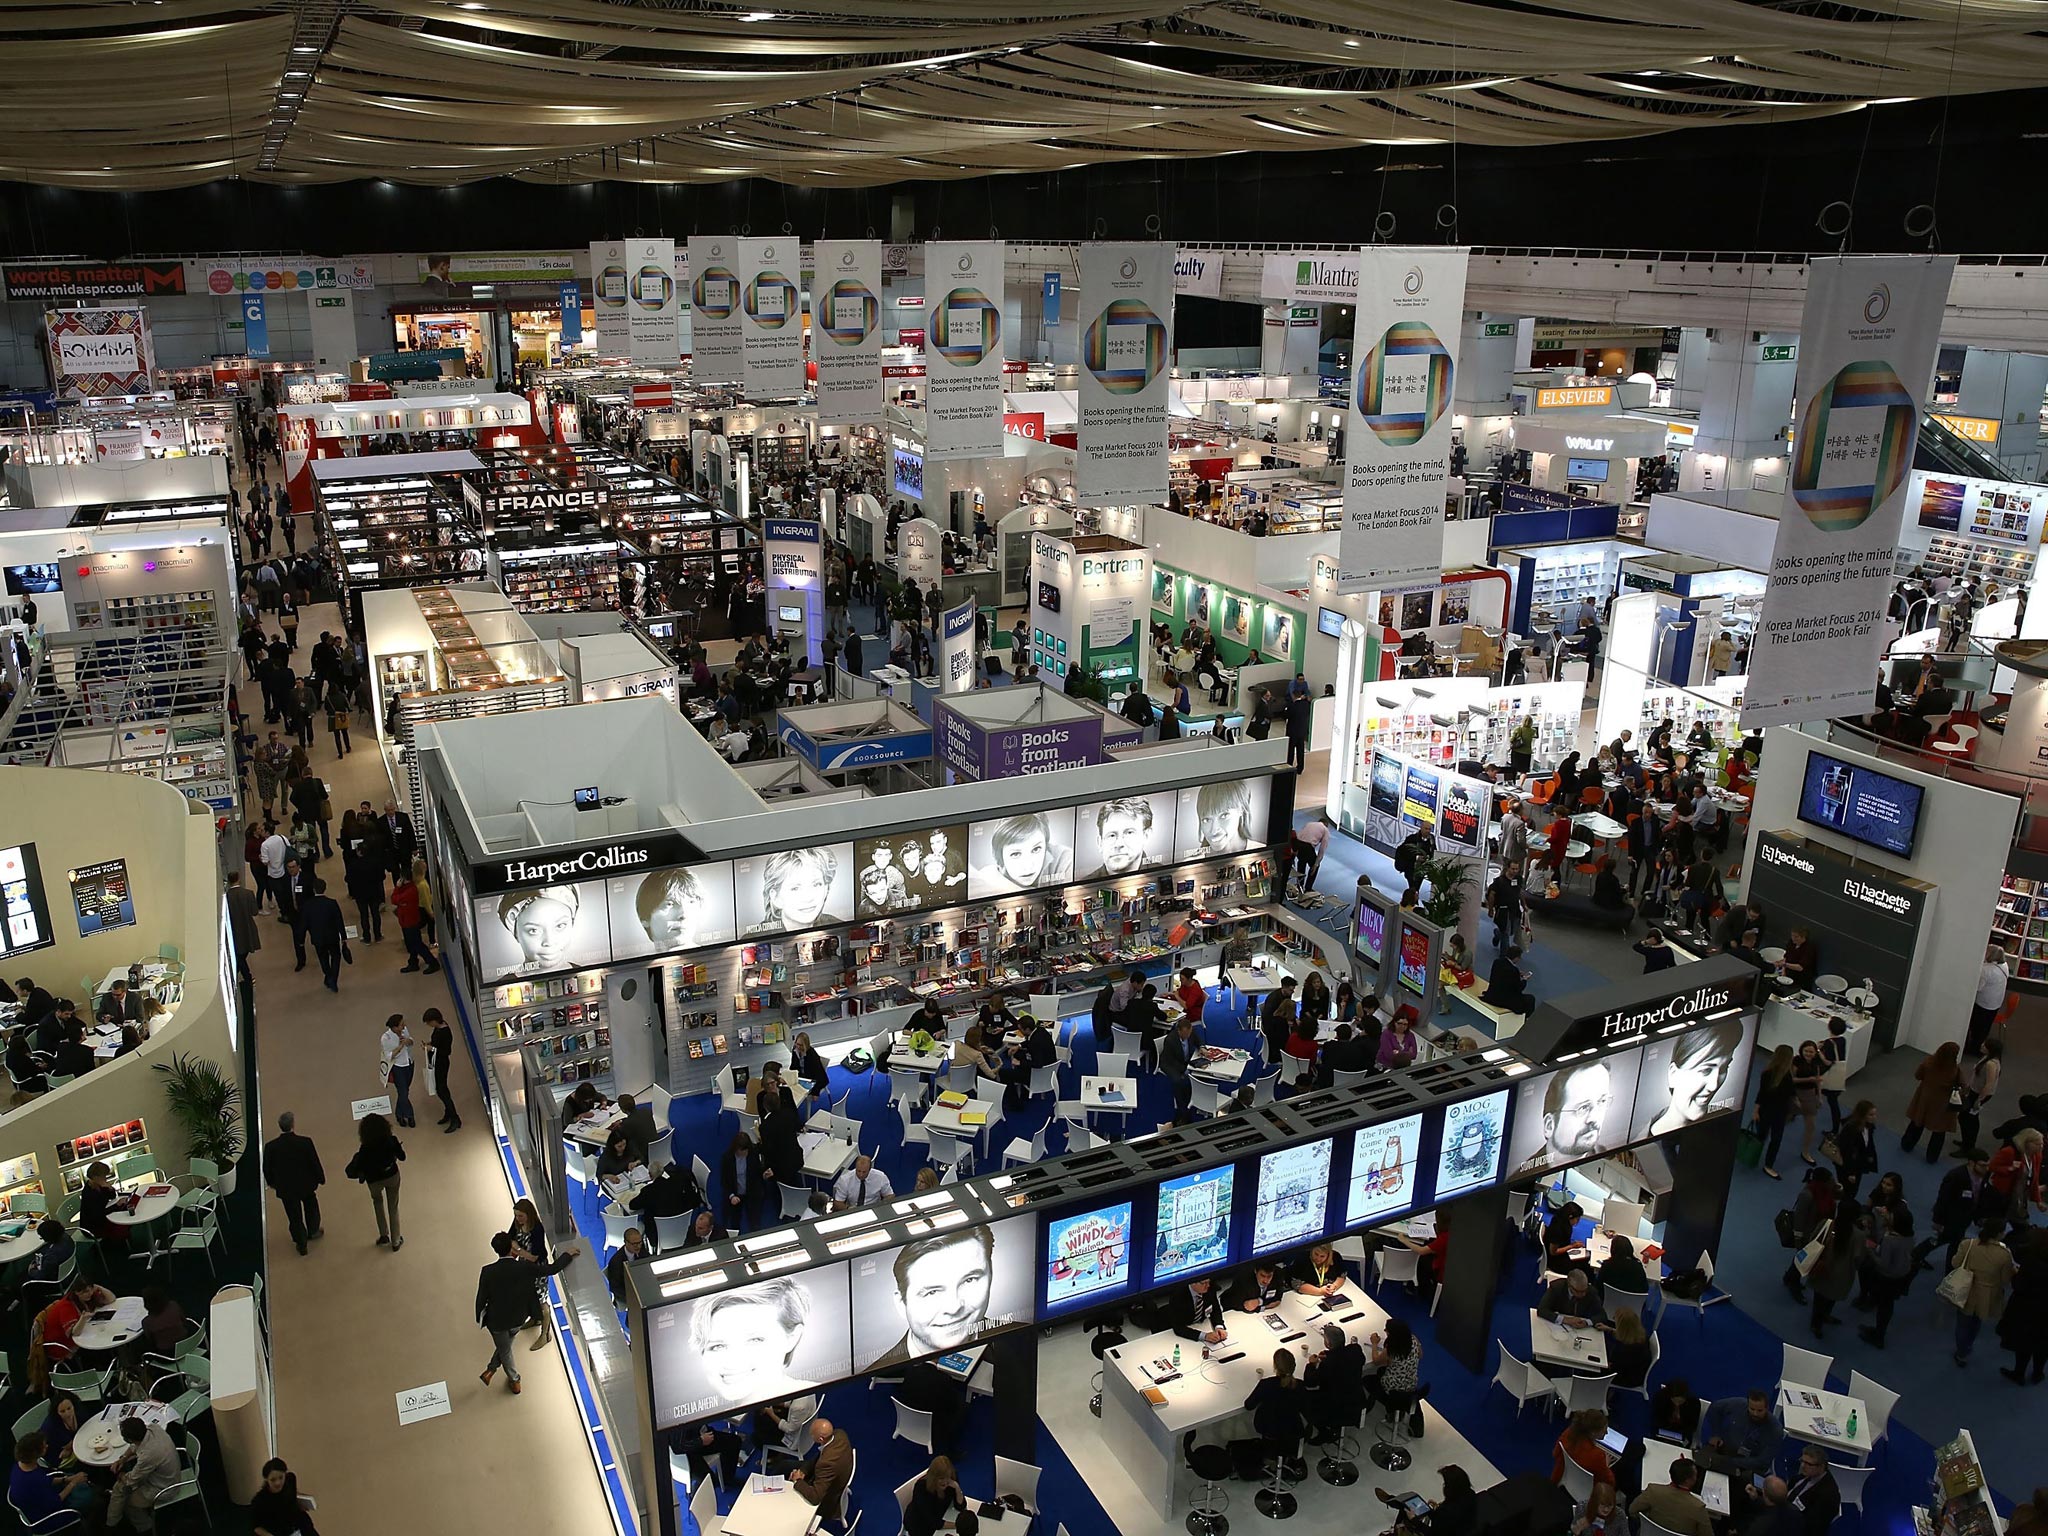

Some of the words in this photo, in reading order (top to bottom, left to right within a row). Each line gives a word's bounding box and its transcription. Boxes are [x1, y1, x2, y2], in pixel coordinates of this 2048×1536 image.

[8, 268, 72, 284] words
[76, 267, 142, 281] matter
[337, 273, 373, 288] Qbend
[10, 283, 144, 298] www.midaspr.co.uk
[1049, 284, 1055, 296] J
[565, 296, 576, 308] H
[247, 306, 262, 321] G
[1541, 328, 1565, 338] seating
[1568, 327, 1581, 336] fine
[1581, 327, 1597, 336] food
[411, 381, 438, 391] FABER
[440, 381, 448, 390] &
[450, 379, 476, 389] FABER
[1542, 390, 1606, 407] ELSEVIER
[1083, 407, 1105, 418] Books
[1106, 406, 1133, 418] opening
[1134, 405, 1146, 415] the
[1146, 404, 1166, 415] mind,
[1083, 417, 1104, 427] Doors
[1104, 416, 1132, 428] opening
[1133, 415, 1144, 425] the
[1145, 415, 1166, 425] future
[1085, 444, 1104, 453] Korea
[1105, 443, 1127, 452] Market
[1127, 442, 1146, 451] Focus
[1147, 441, 1163, 450] 2014
[1565, 435, 1615, 452] WILEY
[1854, 435, 1870, 447] 여는
[1091, 452, 1103, 460] The
[1104, 451, 1127, 460] London
[1128, 450, 1145, 458] Book
[1146, 449, 1158, 457] Fair
[1852, 447, 1867, 460] 여는
[1869, 446, 1878, 459] 문
[1352, 464, 1377, 476] Books
[1377, 462, 1409, 475] opening
[1409, 461, 1423, 472] the
[1423, 458, 1446, 471] mind,
[1351, 477, 1375, 488] Doors
[1376, 475, 1407, 489] opening
[1407, 473, 1421, 484] the
[1421, 471, 1444, 483] future
[499, 491, 595, 511] FRANCE
[1534, 494, 1540, 502] &
[1540, 495, 1564, 508] Robinson
[1352, 511, 1373, 523] Korea
[1374, 509, 1400, 521] Market
[1400, 507, 1421, 518] Focus
[1421, 505, 1440, 516] 2014
[773, 526, 814, 537] INGRAM
[1357, 521, 1371, 532] The
[1372, 519, 1399, 531] London
[1399, 517, 1418, 528] Book
[1418, 515, 1433, 527] Fair
[772, 553, 806, 563] PHYSICAL
[1035, 538, 1070, 563] Bertram
[1804, 551, 1844, 569] opening
[1846, 549, 1864, 564] the
[1865, 546, 1894, 564] mind,
[92, 563, 129, 573] macmillan
[157, 558, 193, 568] macmillan
[772, 560, 799, 569] DIGITAL
[1082, 558, 1144, 577] Bertram
[772, 567, 818, 578] DISTRIBUTION
[1801, 570, 1841, 588] opening
[1842, 568, 1860, 582] the
[1861, 566, 1892, 581] future
[949, 608, 973, 631] INGRAM
[1764, 618, 1792, 633] Korea
[1793, 614, 1828, 630] Market
[1829, 612, 1856, 628] Focus
[1857, 610, 1882, 625] 2014
[1770, 631, 1788, 646] The
[1790, 628, 1826, 645] London
[1827, 626, 1852, 641] Book
[1853, 623, 1872, 638] Fair
[950, 649, 967, 665] BOOKS
[950, 656, 970, 674] E-BOOKS
[950, 661, 974, 683] TEXTBOOKS
[625, 677, 675, 697] INGRAM
[946, 713, 971, 742] Books
[946, 730, 966, 754] from
[1020, 729, 1069, 748] Books
[854, 749, 904, 763] BOOKSOURCE
[1020, 747, 1059, 763] from
[946, 747, 980, 782] Scotland
[1020, 756, 1087, 776] Scotland
[1407, 781, 1437, 798] HOROWITZ
[1408, 775, 1437, 790] ANTHONY
[1448, 795, 1478, 811] HARLAN
[1448, 803, 1475, 817] COBEN
[1857, 801, 1876, 812] BETRAYAL
[1876, 807, 1886, 815] AND
[1885, 810, 1894, 818] THE
[1858, 797, 1871, 806] STORY
[1444, 808, 1477, 828] MISSING
[1855, 810, 1866, 819] TIME
[1452, 820, 1467, 835] YOU
[504, 845, 649, 883] HarperCollins
[1774, 847, 1815, 875] hachette
[76, 870, 101, 880] GILLIAN
[103, 865, 123, 876] FLYNN
[1861, 881, 1912, 910] hachette
[1860, 894, 1875, 905] BOOK
[1874, 898, 1894, 911] GROUP
[1893, 905, 1906, 916] USA
[1360, 902, 1385, 936] LUCKY
[1601, 986, 1730, 1039] HarperCollins
[1462, 1098, 1491, 1116] MOG
[1488, 1106, 1500, 1117] Cat
[1361, 1130, 1375, 1141] The
[1377, 1124, 1397, 1140] Tiger
[1398, 1119, 1417, 1131] Who
[1360, 1136, 1382, 1150] Came
[1359, 1150, 1368, 1160] to
[1368, 1146, 1384, 1157] Tea
[1183, 1197, 1209, 1215] Fairy
[1183, 1210, 1208, 1225] Tales
[1066, 1217, 1099, 1237] Rudolph's
[1065, 1226, 1109, 1250] WINDY
[1069, 1239, 1105, 1259] Christmas
[673, 1400, 698, 1420] CECELIA
[697, 1394, 719, 1412] AHERN
